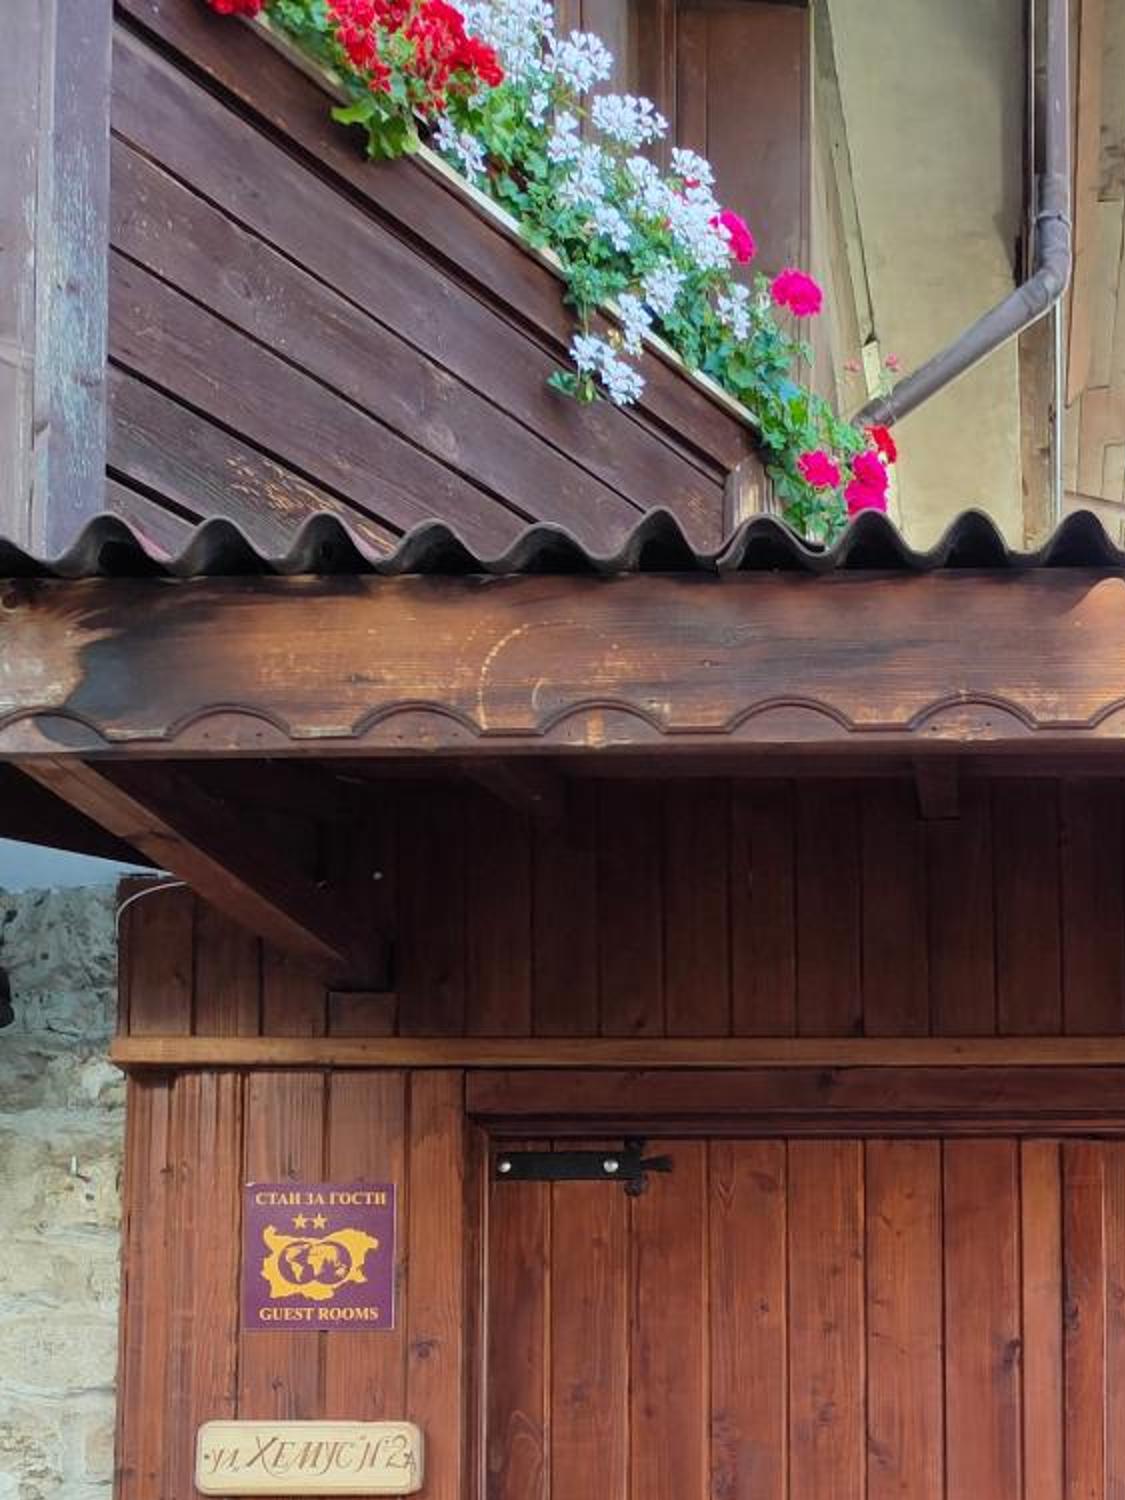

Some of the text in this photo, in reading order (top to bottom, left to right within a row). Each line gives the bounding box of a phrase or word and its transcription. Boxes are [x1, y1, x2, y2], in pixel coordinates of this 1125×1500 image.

[255, 1191, 386, 1205] СТАИ ЗА ГОСТИ
[259, 1307, 379, 1321] GUEST ROOMS
